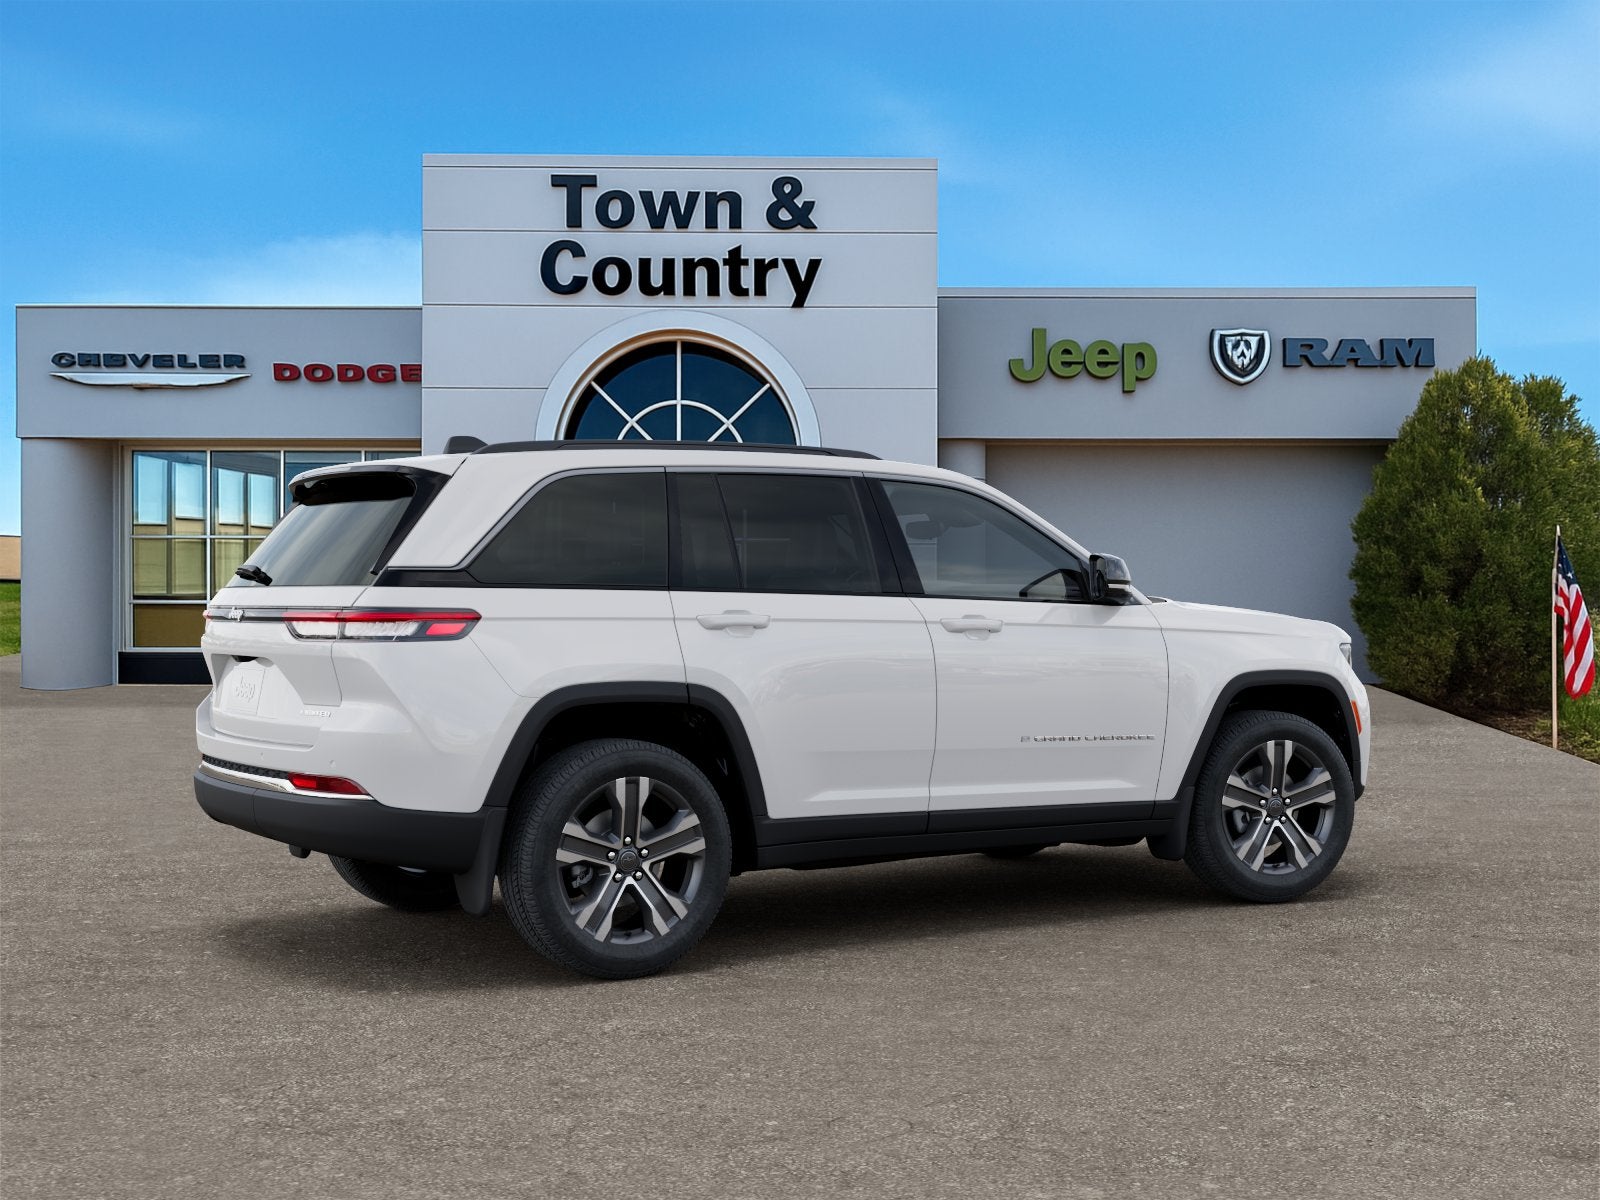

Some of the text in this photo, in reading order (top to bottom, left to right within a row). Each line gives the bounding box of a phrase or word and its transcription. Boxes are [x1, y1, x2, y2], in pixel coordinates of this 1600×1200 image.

[550, 173, 818, 230] Town &
[540, 239, 823, 309] Country
[272, 362, 422, 383] DODGE
[1009, 327, 1158, 393] Jeep
[1282, 336, 1436, 369] RAM
